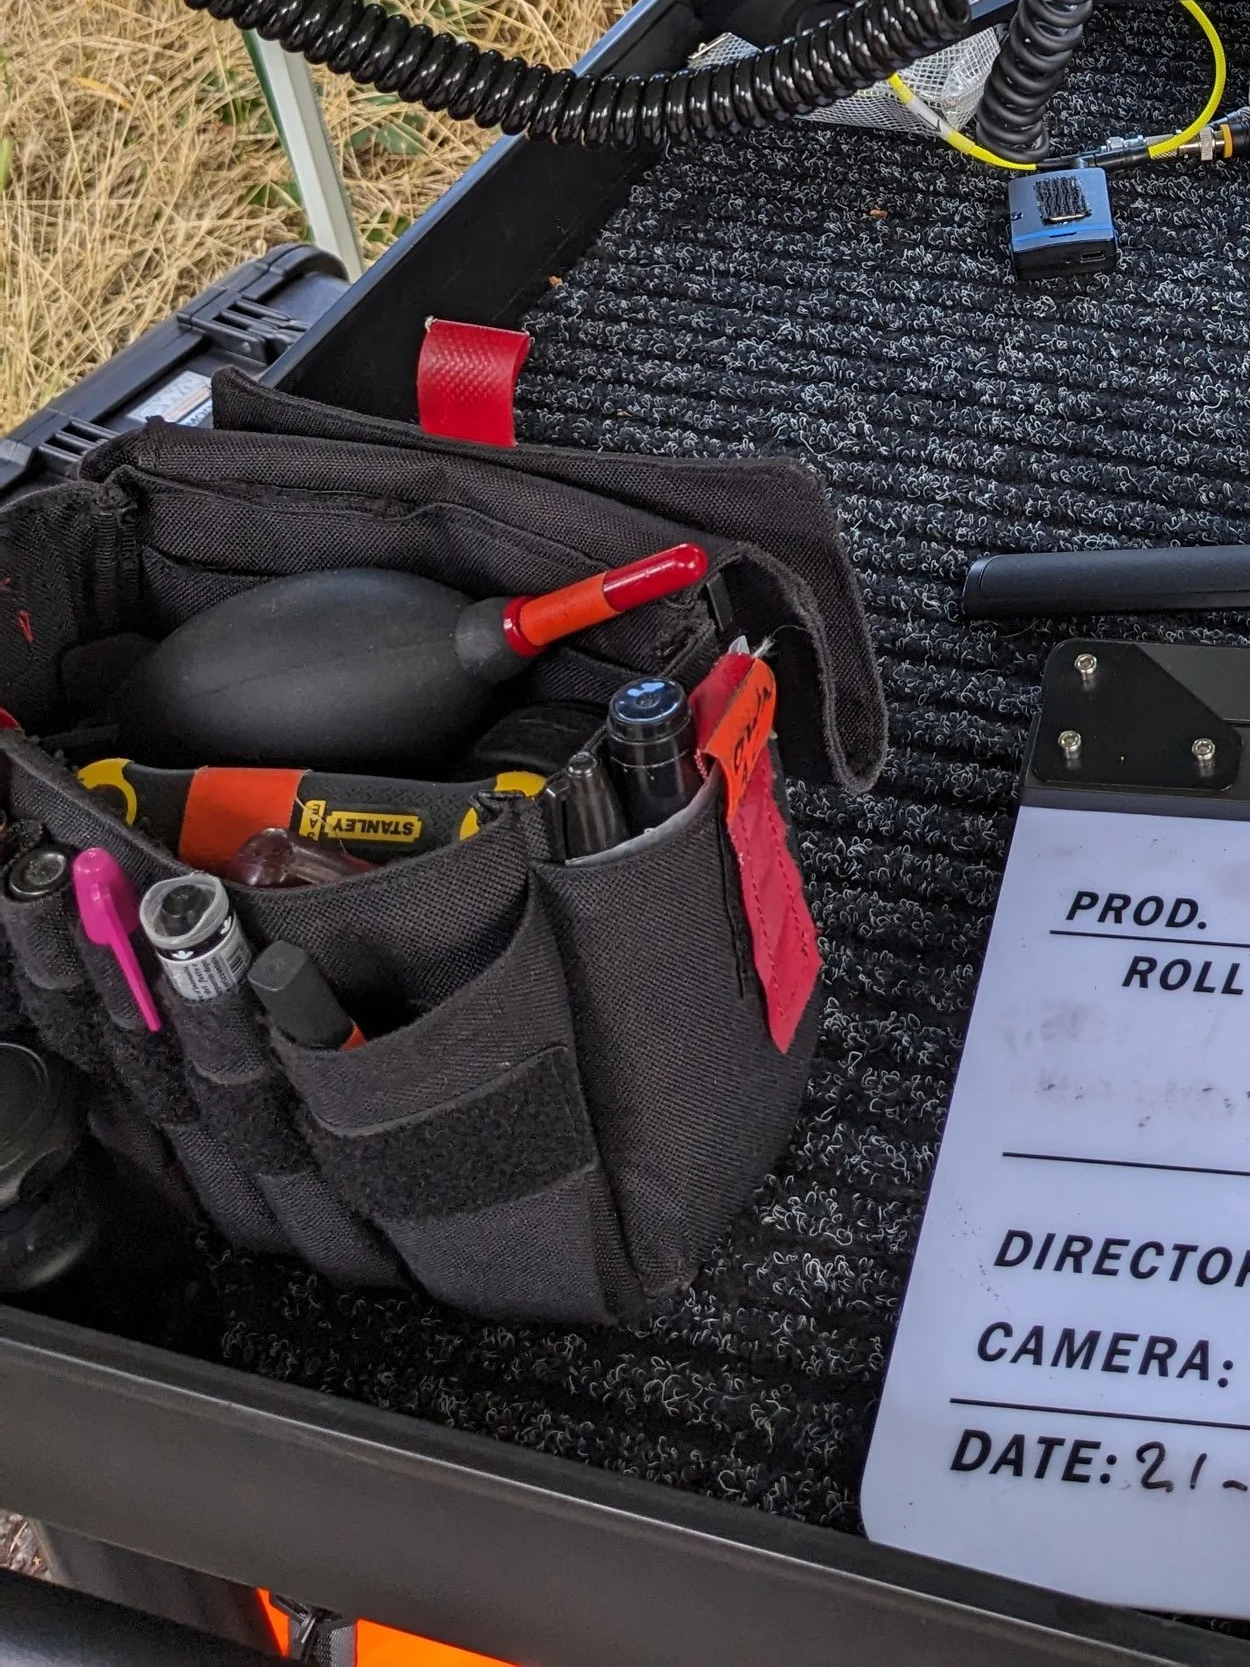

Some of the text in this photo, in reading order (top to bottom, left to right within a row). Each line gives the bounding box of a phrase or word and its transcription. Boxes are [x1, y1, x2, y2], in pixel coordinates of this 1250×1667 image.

[332, 817, 416, 836] STANLEY
[1065, 890, 1208, 930] PROD.
[1121, 956, 1245, 996] ROLL
[976, 1320, 1234, 1388] CAMERA:
[949, 1428, 1119, 1485] DATE:
